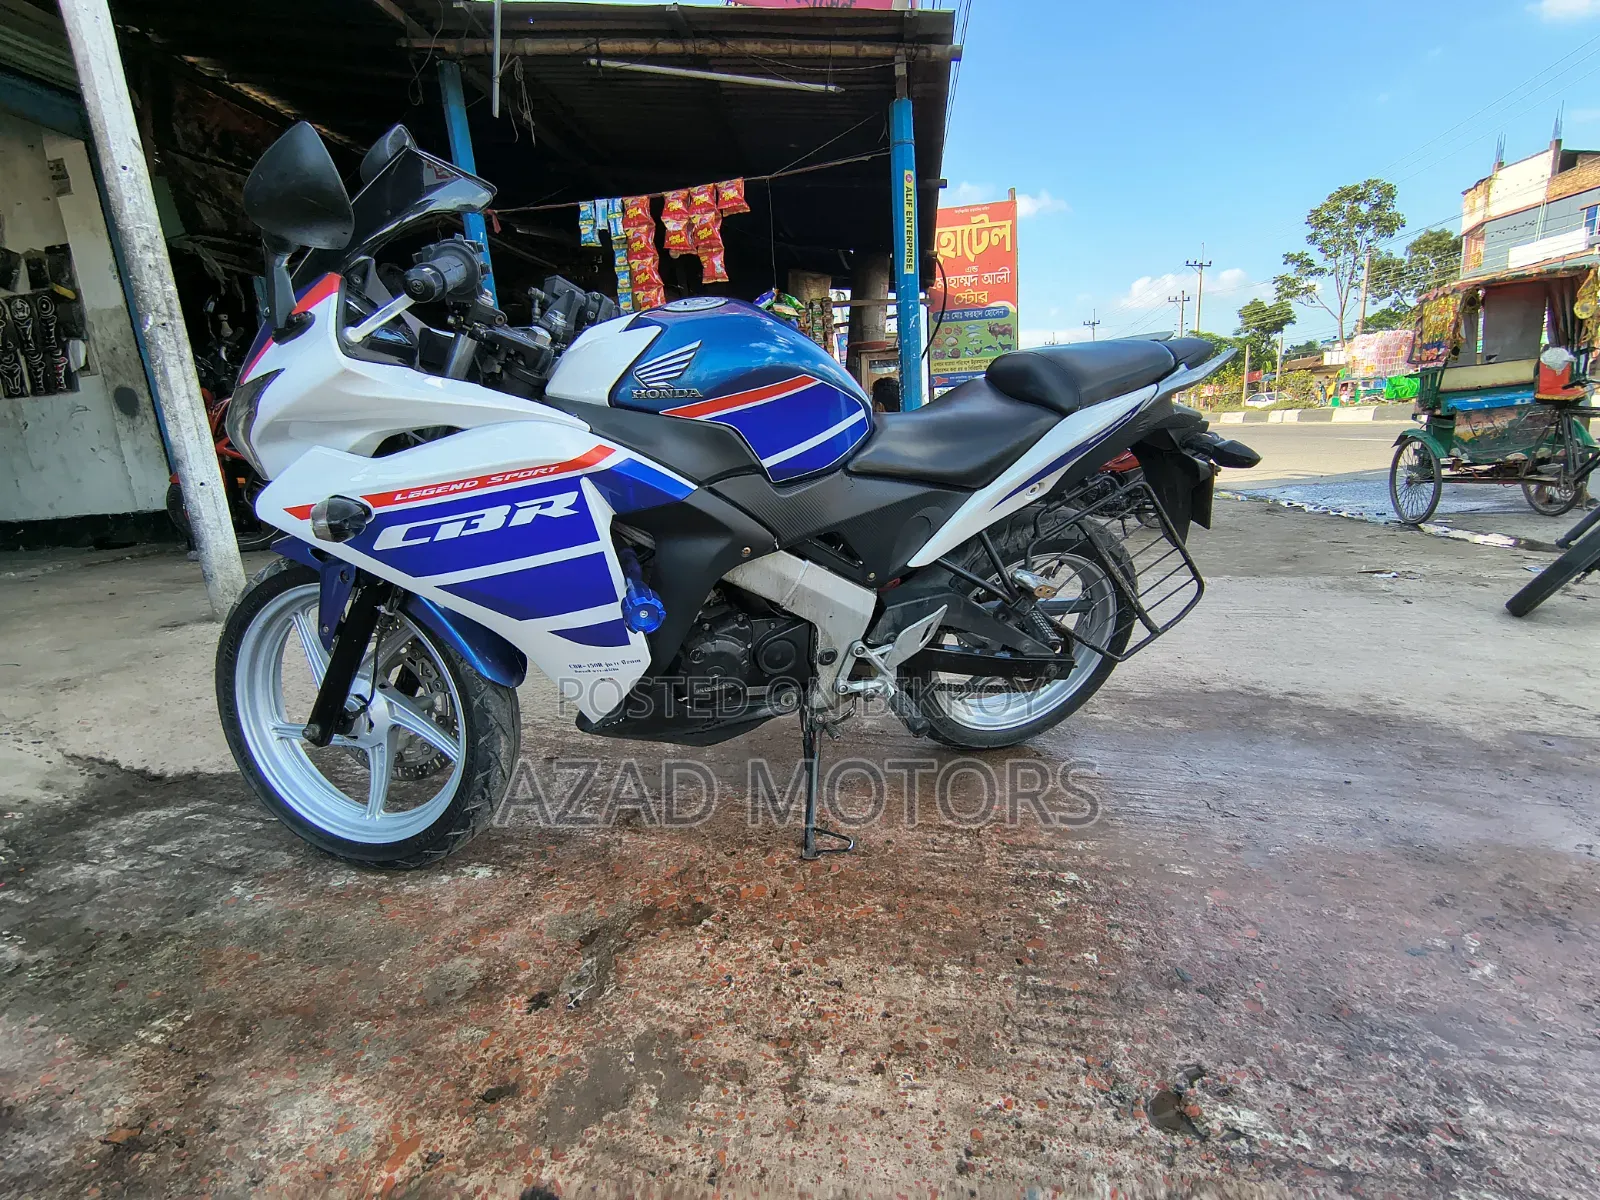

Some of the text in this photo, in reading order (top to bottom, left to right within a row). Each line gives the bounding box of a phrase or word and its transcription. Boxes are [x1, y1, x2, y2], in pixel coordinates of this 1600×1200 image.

[905, 186, 913, 270] ALIF ENTERPRISE
[981, 266, 1011, 285] আলী
[954, 289, 988, 305] স্টোর
[631, 388, 703, 399] HONDA
[394, 465, 560, 501] LEGEND SPORT
[372, 491, 580, 551] CBR
